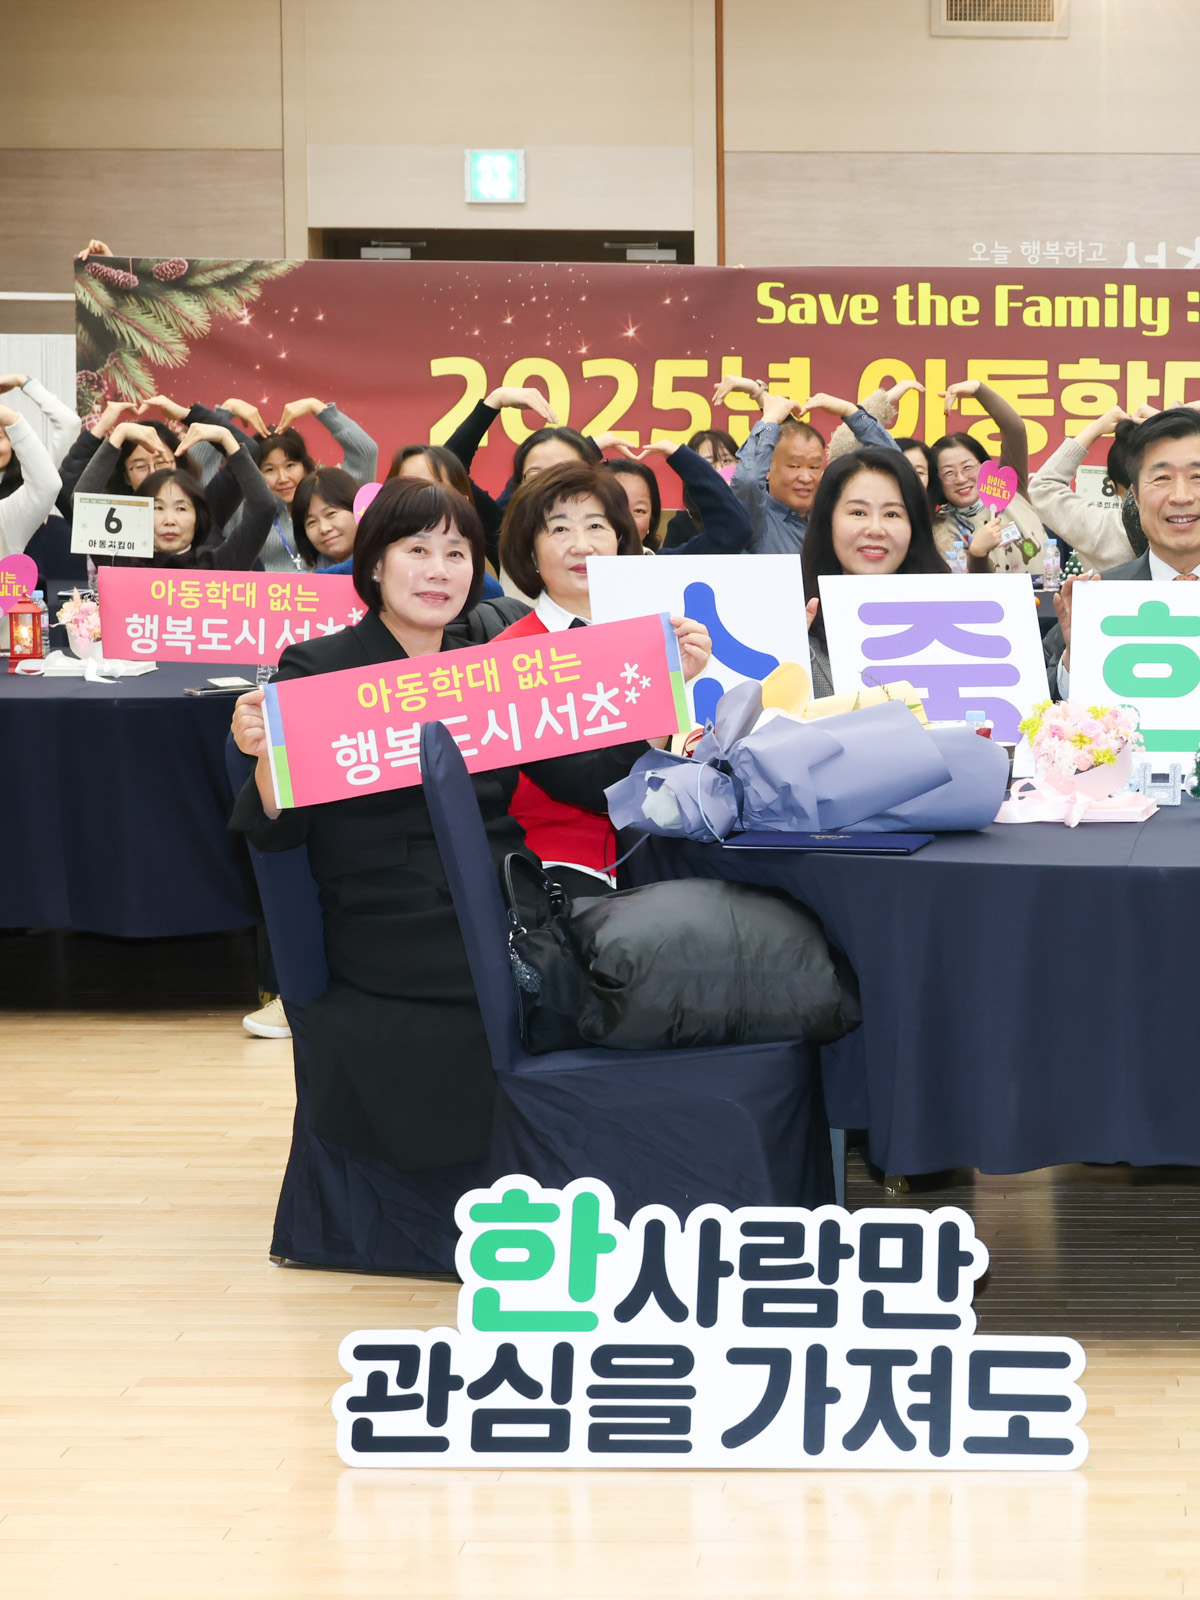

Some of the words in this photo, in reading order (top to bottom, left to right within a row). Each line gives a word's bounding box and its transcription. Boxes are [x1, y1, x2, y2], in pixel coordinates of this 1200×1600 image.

[968, 240, 1012, 265] 오늘
[1020, 240, 1108, 265] 행복하고
[757, 281, 878, 324] Save
[893, 283, 979, 325] the
[995, 284, 1169, 336] Family
[1101, 476, 1116, 497] 8
[104, 507, 123, 534] 6
[150, 578, 257, 610] 아동학대
[267, 583, 320, 612] 없는
[125, 613, 266, 656] 행복도시
[357, 657, 501, 714] 아동학대
[511, 647, 582, 692] 없는
[534, 681, 628, 742] 서초
[346, 1340, 697, 1453] 관심을
[720, 1342, 1075, 1458] 가져도
